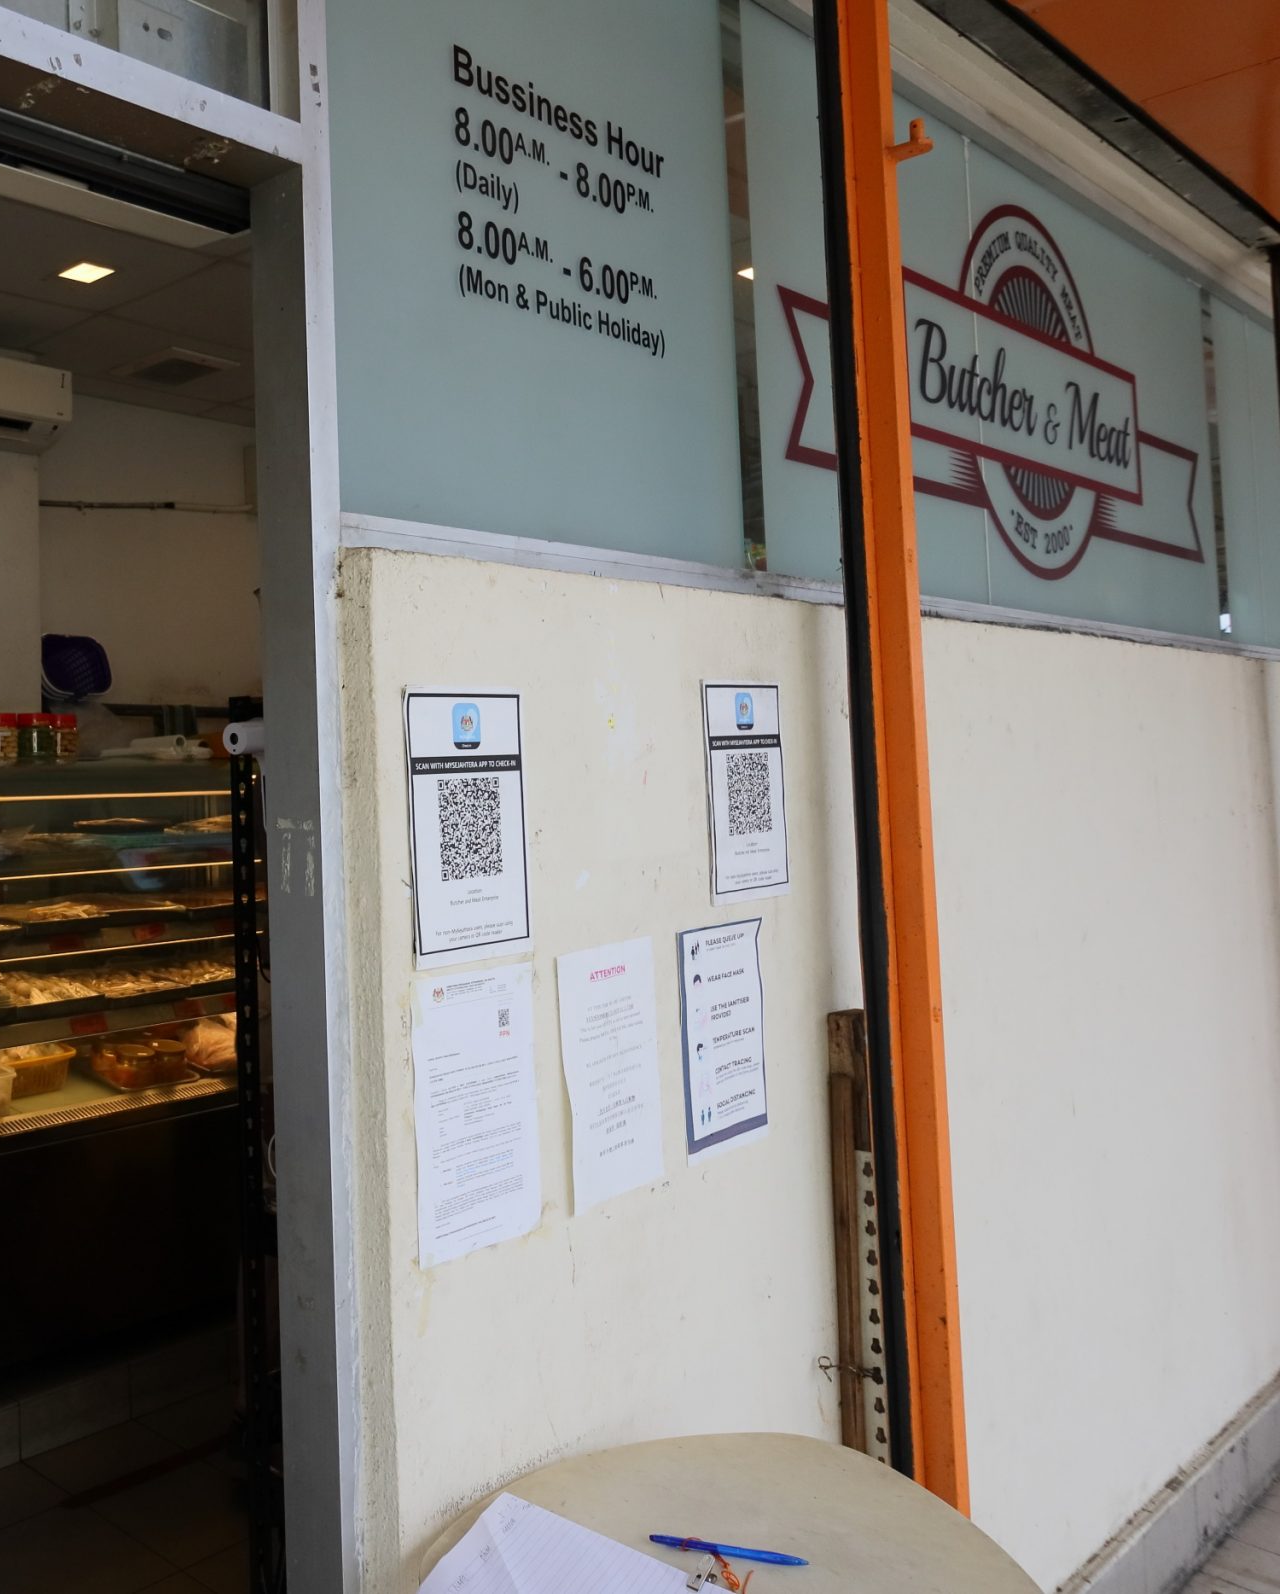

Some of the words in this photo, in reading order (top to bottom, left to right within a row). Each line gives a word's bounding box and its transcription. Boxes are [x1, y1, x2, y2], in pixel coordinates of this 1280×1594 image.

[453, 44, 598, 147] Bussiness
[607, 120, 664, 178] Hour
[456, 160, 519, 213] (Daily)
[459, 264, 509, 304] (Mon
[516, 283, 530, 311] &
[536, 290, 593, 331] Public
[598, 310, 666, 359] Holiday)
[973, 230, 1011, 296] PREMIUM
[1014, 231, 1060, 285] QUALITY
[1059, 288, 1084, 343] MEAT
[914, 317, 1038, 437] Butcher
[1043, 402, 1060, 445] &
[1065, 381, 1133, 469] Meat
[1014, 516, 1038, 551] EST
[1044, 525, 1071, 556] 2000
[415, 762, 430, 771] SCAN
[430, 761, 444, 770] WITH
[444, 760, 478, 770] MYSEJAHTERA
[478, 760, 488, 768] APP
[488, 760, 495, 768] TO
[495, 759, 517, 768] CHECK-IN
[590, 964, 626, 980] ATTENTION
